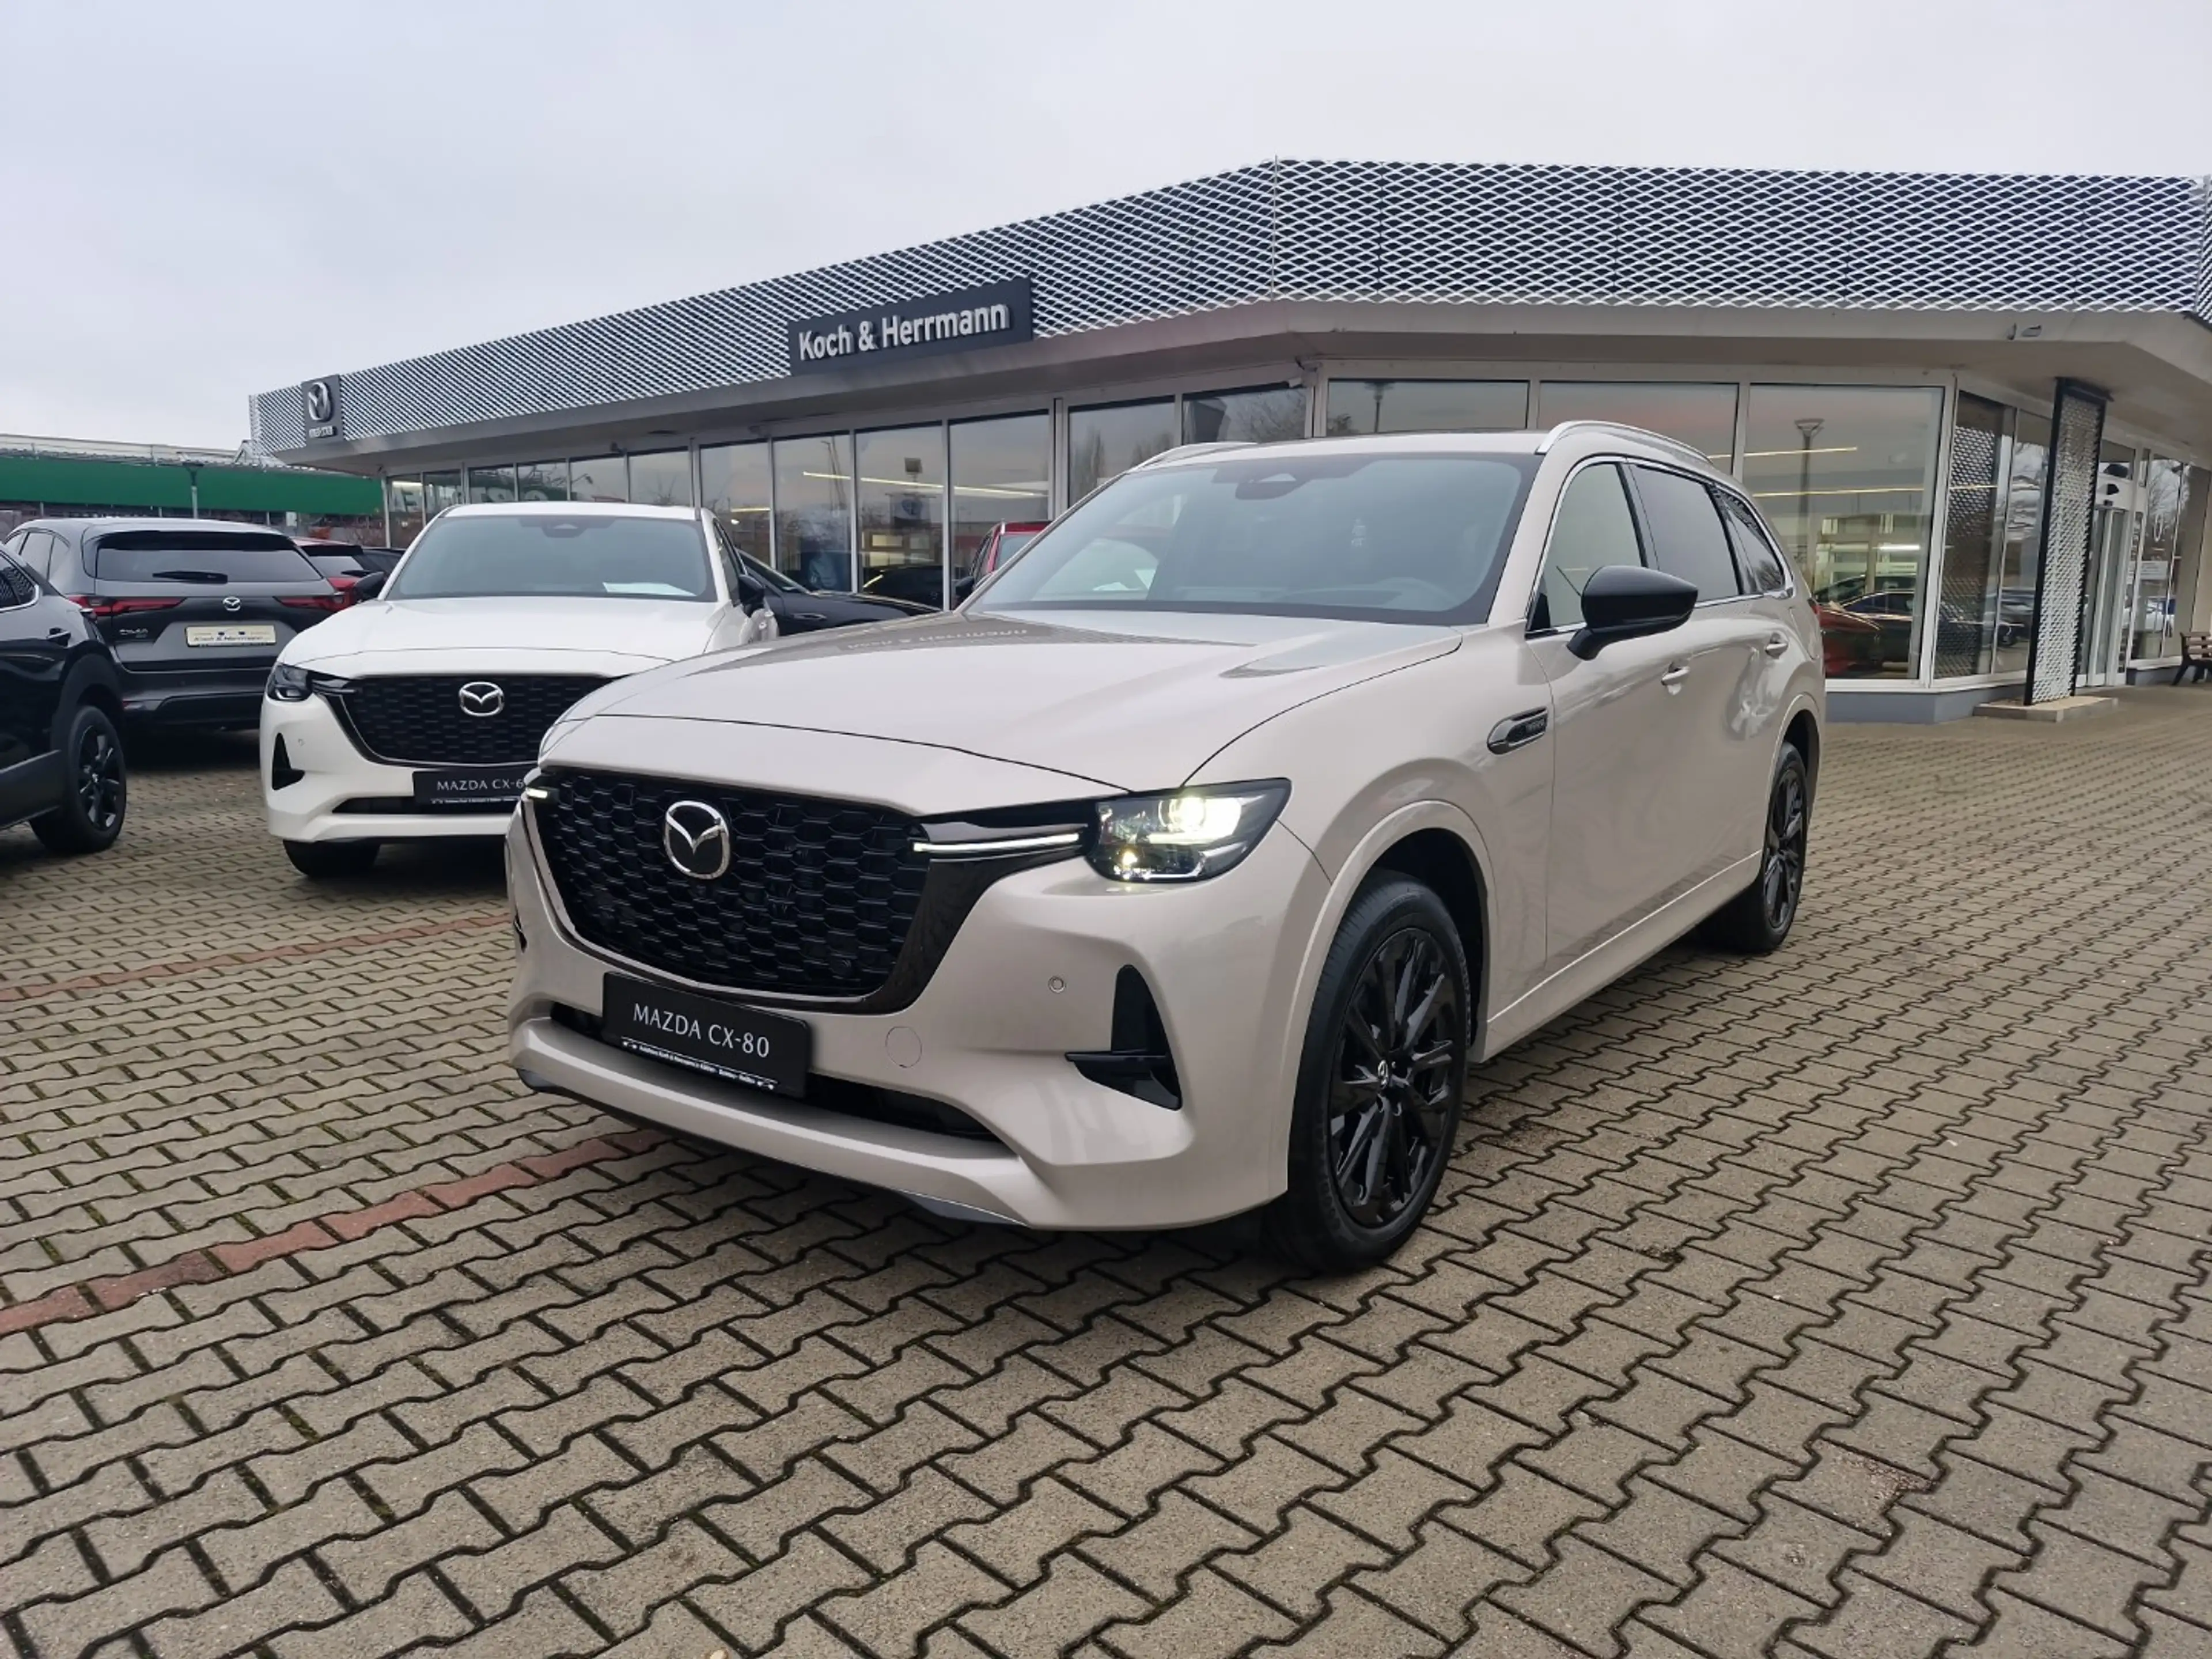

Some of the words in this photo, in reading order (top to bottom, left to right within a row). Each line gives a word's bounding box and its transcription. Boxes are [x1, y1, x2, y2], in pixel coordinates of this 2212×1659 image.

[799, 324, 853, 361] Koch
[859, 320, 878, 351] &
[882, 304, 1009, 347] Herrmann
[437, 780, 488, 791] MAZDA
[491, 779, 524, 789] CX-6
[633, 1003, 702, 1040] MAZDA
[708, 1024, 770, 1058] CX-80
